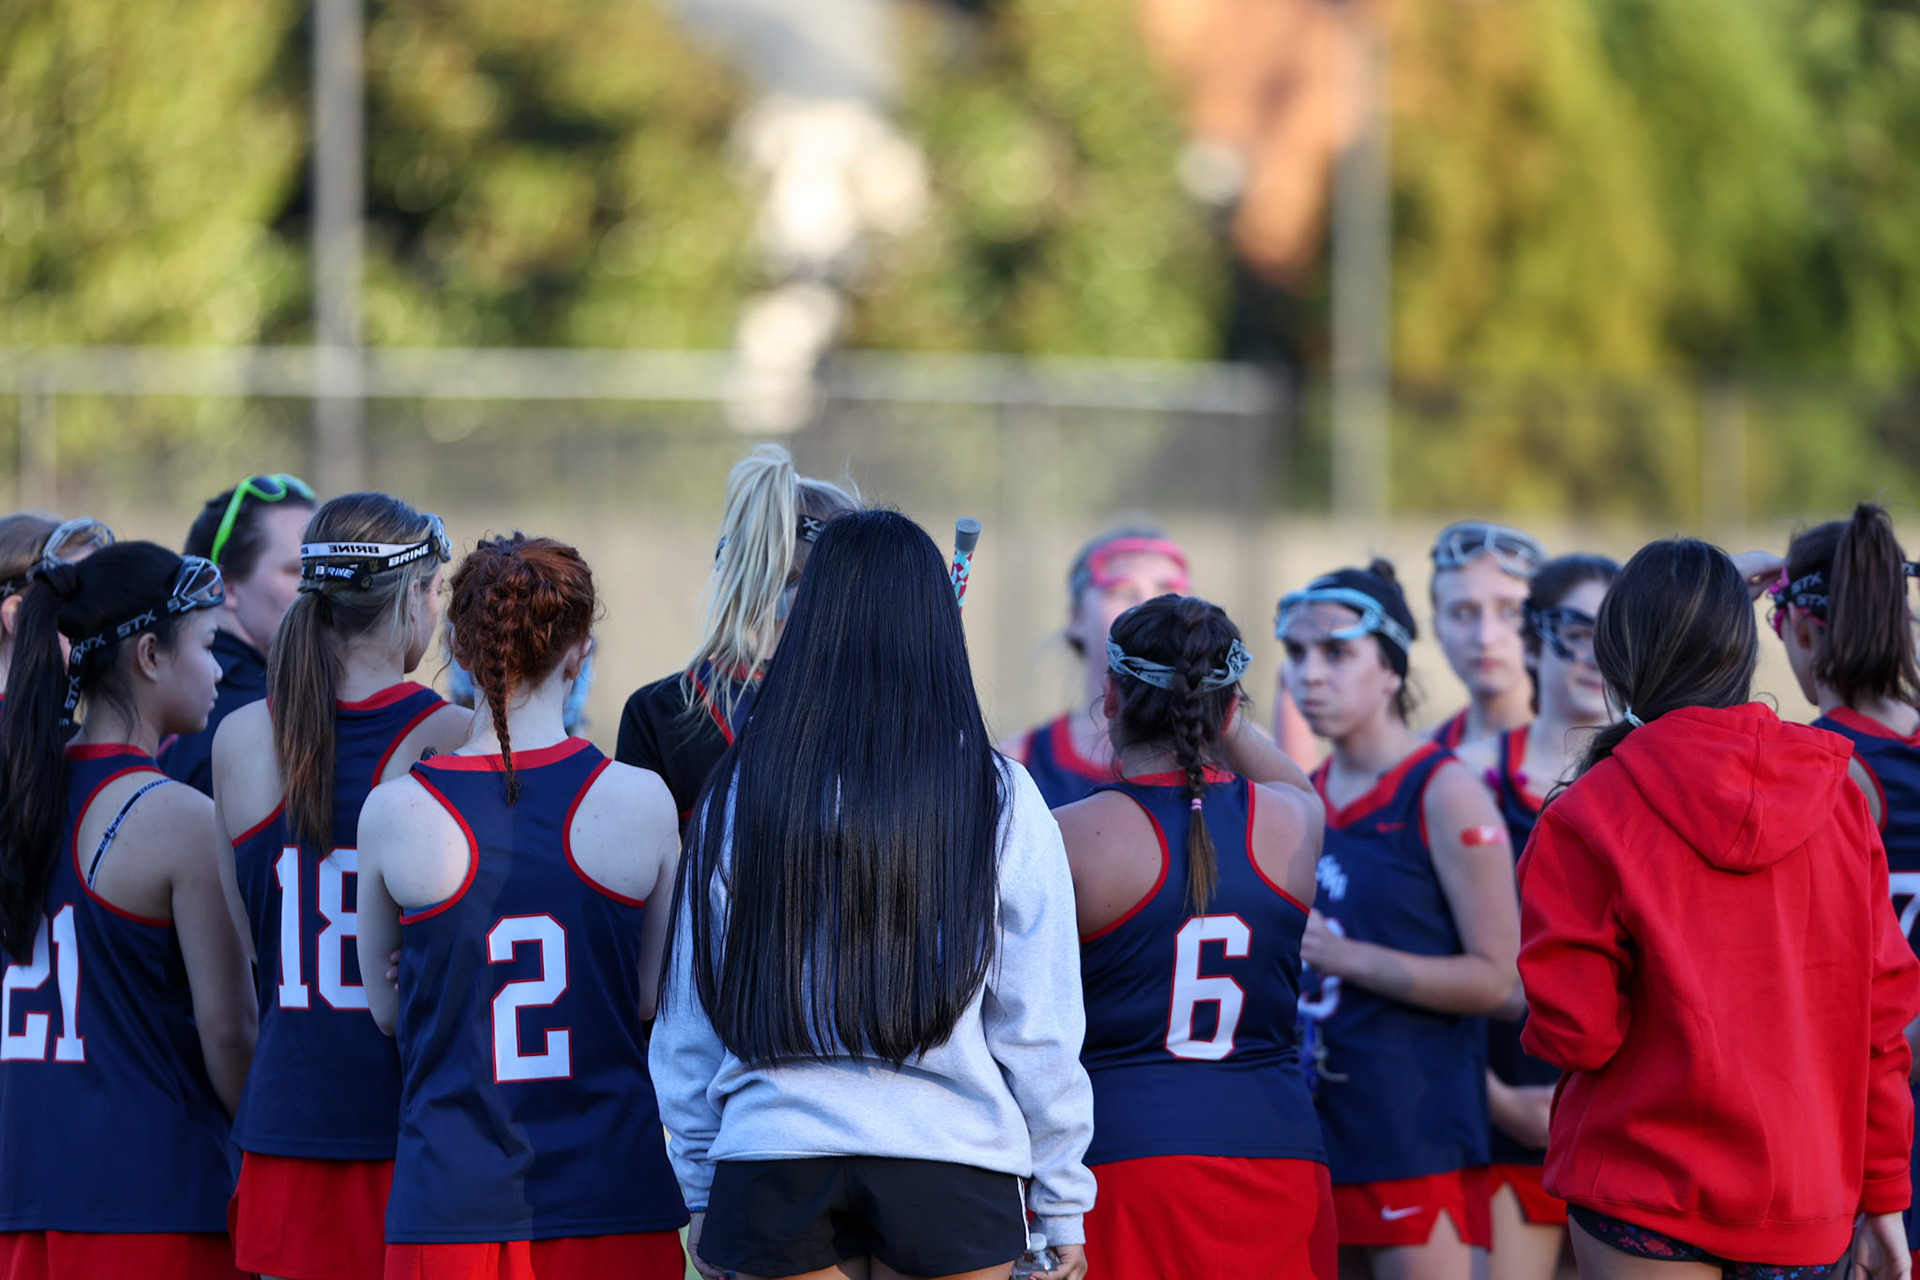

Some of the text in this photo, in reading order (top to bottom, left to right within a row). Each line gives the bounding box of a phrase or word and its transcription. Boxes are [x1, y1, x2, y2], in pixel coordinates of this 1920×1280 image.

[116, 609, 158, 639] STX
[387, 543, 430, 568] BRINE
[64, 674, 81, 711] STX
[0, 902, 87, 1063] 21
[273, 844, 370, 1010] 18
[487, 912, 573, 1084] 2
[1163, 912, 1253, 1061] 6
